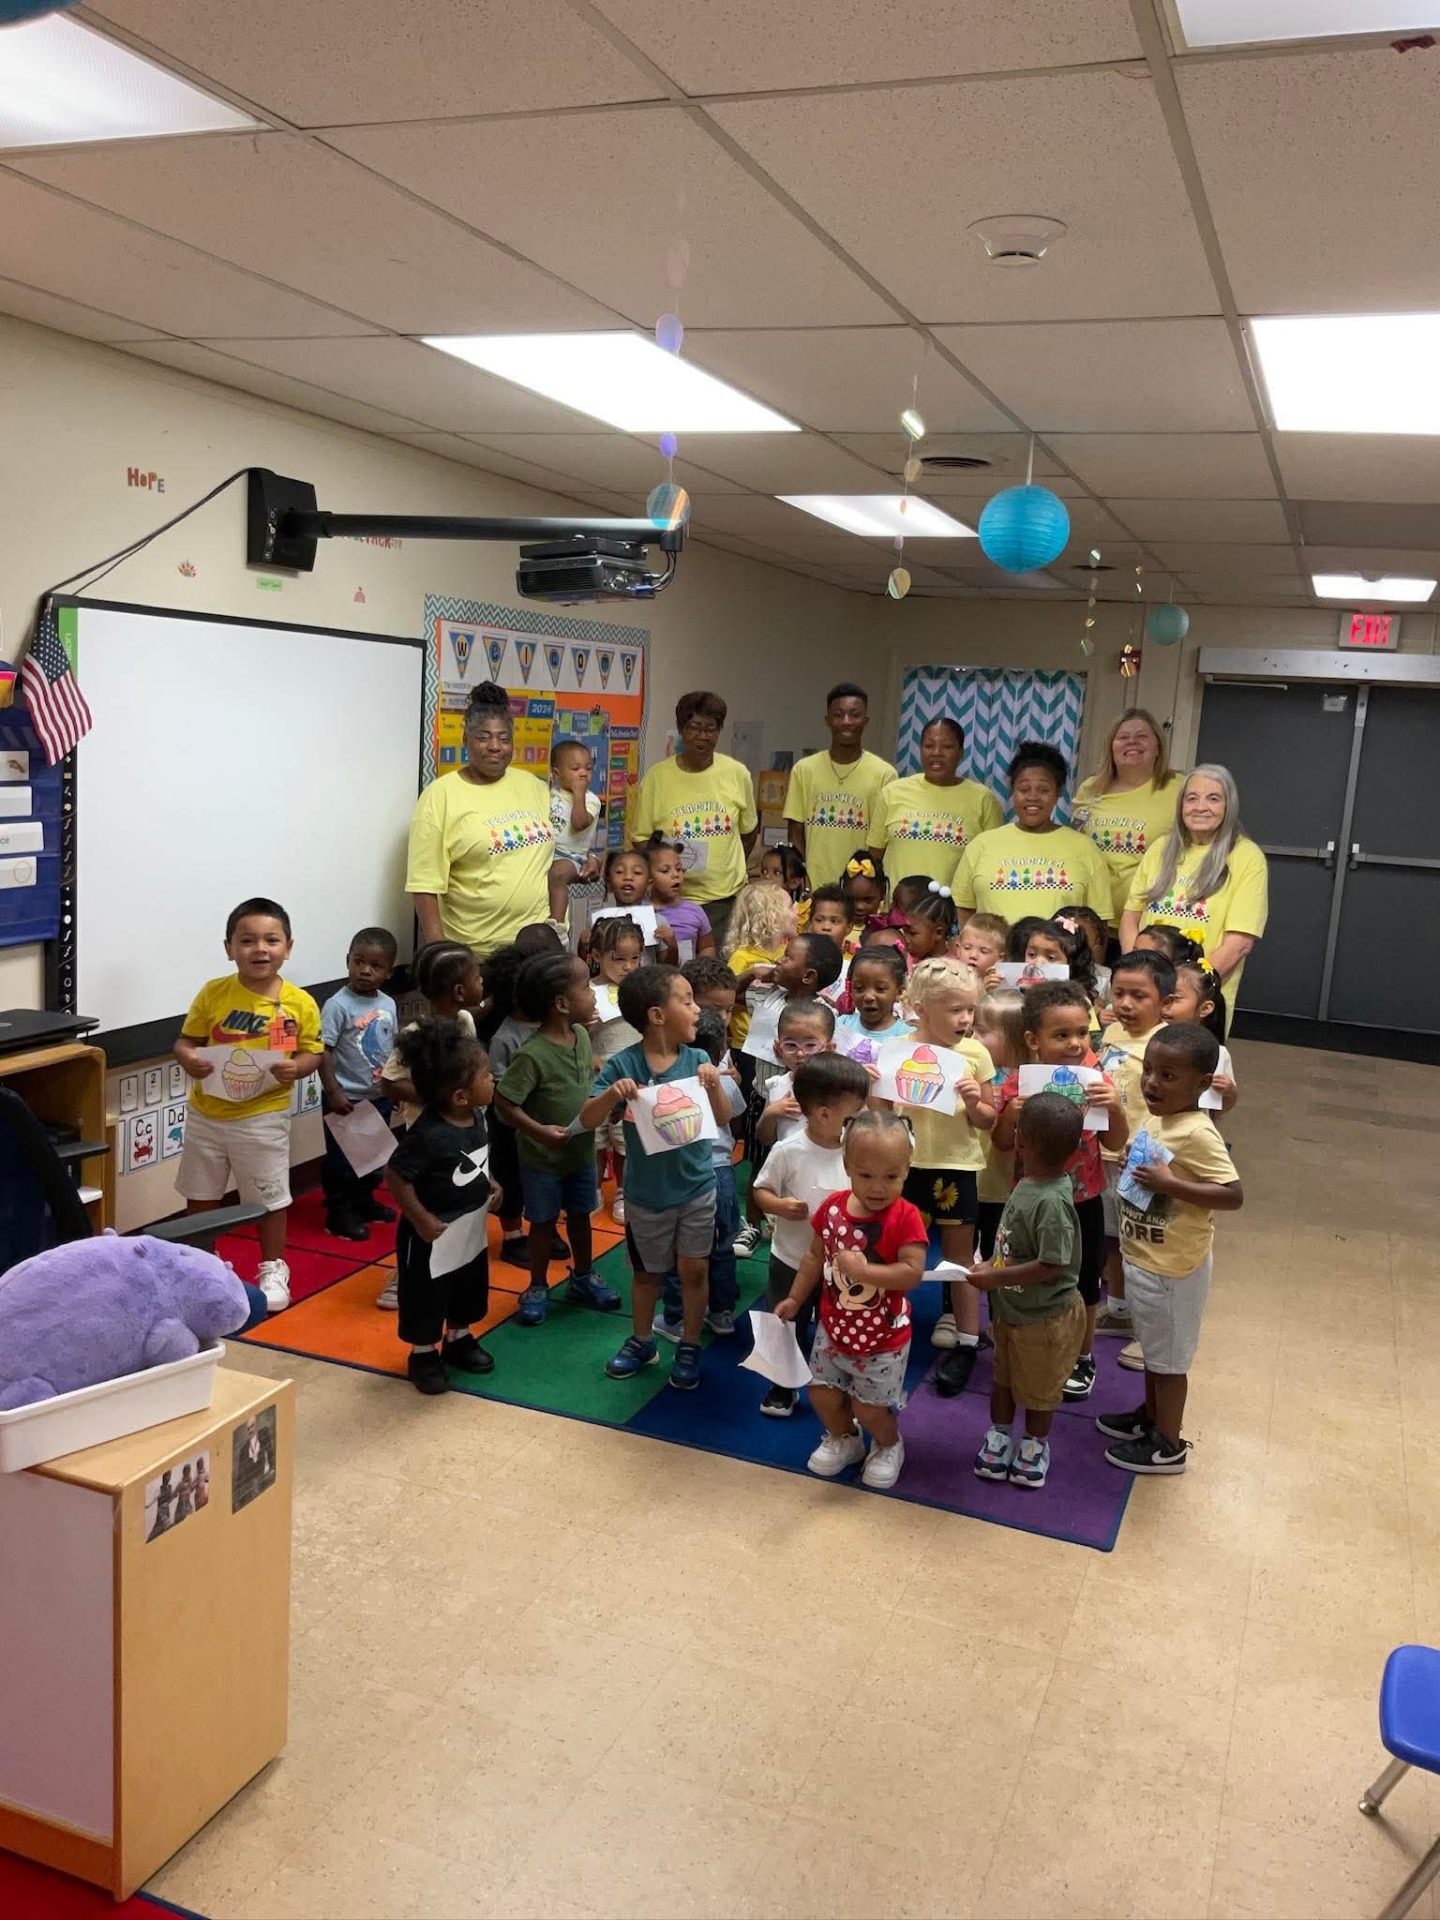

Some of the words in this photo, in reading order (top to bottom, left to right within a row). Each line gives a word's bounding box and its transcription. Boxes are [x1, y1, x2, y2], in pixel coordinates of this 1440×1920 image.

[1350, 614, 1392, 646] EXIT
[671, 800, 726, 817] TEACHER
[221, 1009, 271, 1034] NIKE
[150, 1073, 157, 1084] 2
[174, 1066, 181, 1077] 3
[167, 1105, 186, 1127] Dd
[135, 1119, 153, 1137] Cc
